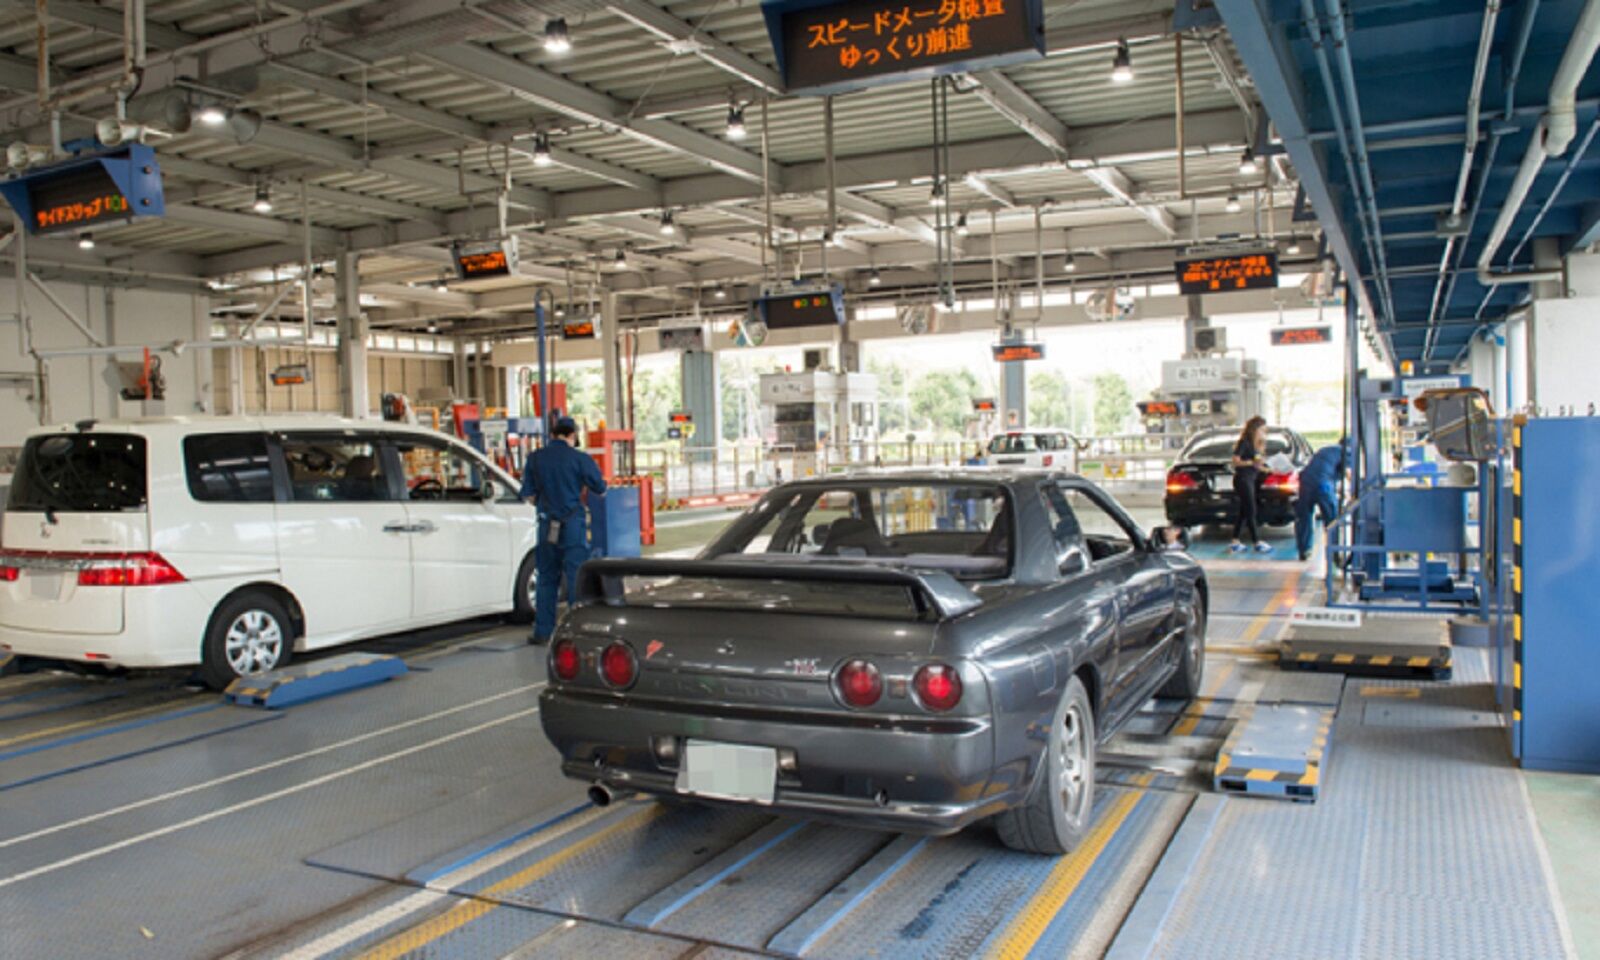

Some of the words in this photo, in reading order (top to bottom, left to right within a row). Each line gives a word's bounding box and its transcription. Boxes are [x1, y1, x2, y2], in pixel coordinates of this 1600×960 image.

[808, 0, 1005, 48] スピードメータ検査
[839, 23, 972, 68] ゆっくり前進
